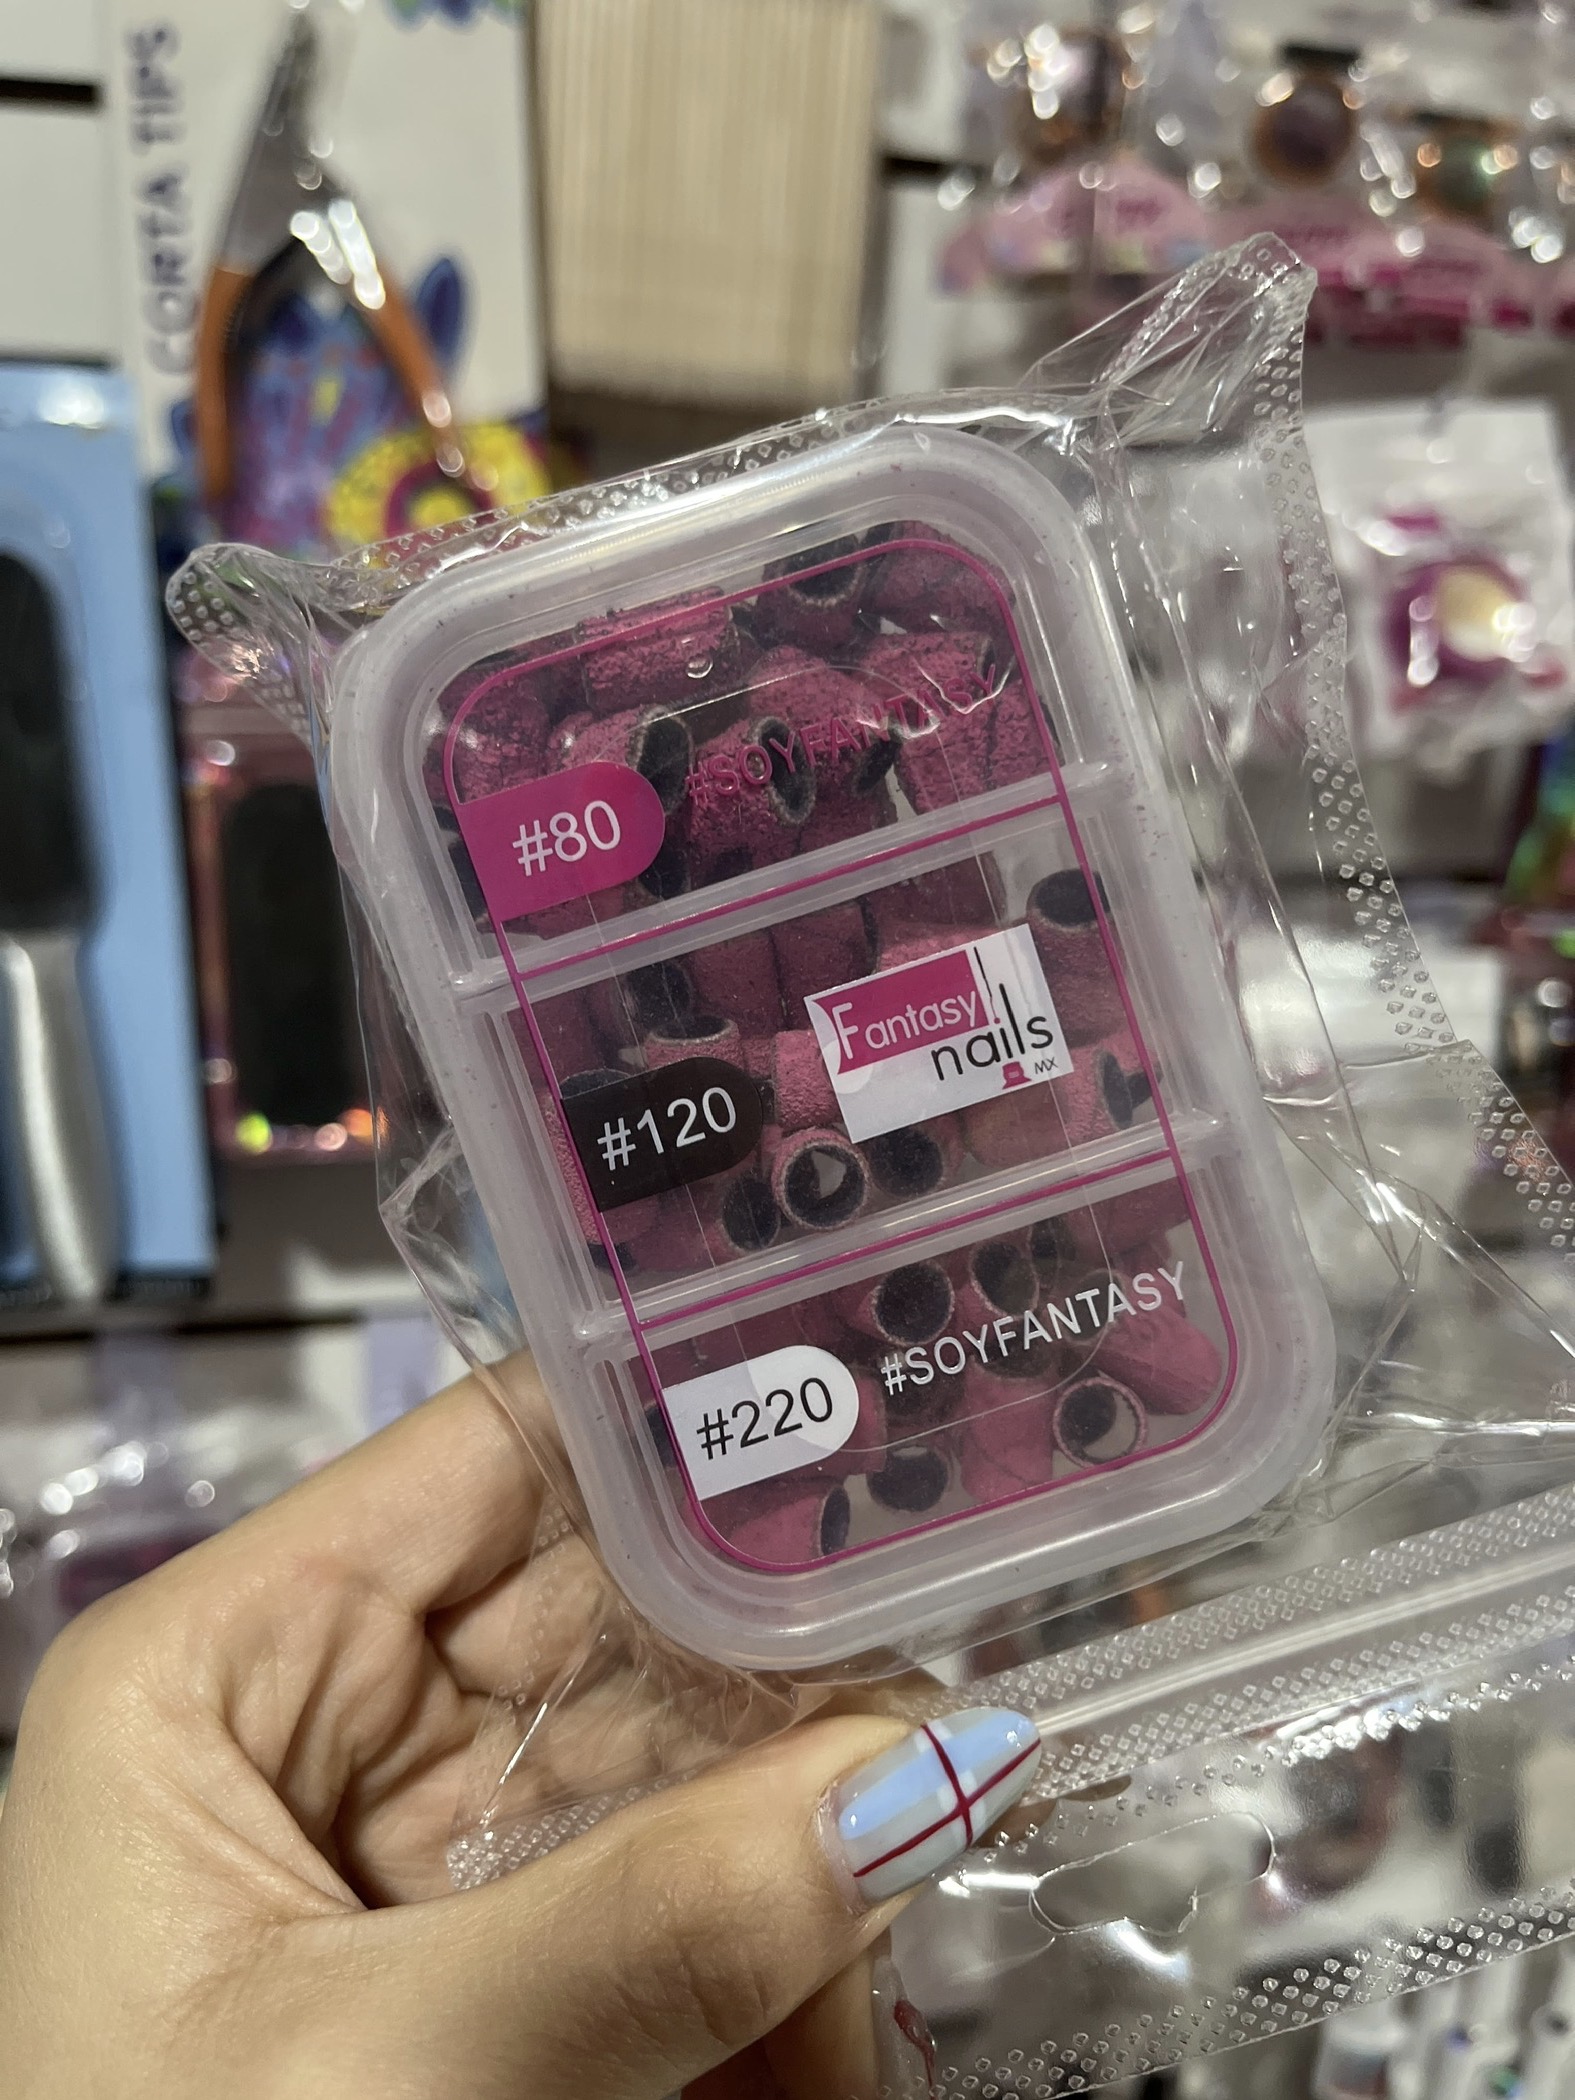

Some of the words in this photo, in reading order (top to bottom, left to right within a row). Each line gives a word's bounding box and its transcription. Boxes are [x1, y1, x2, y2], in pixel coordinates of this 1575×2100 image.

[128, 25, 181, 150] TIPS
[138, 174, 193, 374] CORTA
[687, 665, 997, 803] #SOYFANTASY
[512, 800, 621, 876] #80
[831, 990, 976, 1060] Fantasy
[931, 983, 1054, 1081] nails
[1034, 1057, 1059, 1074] MX
[597, 1085, 737, 1171] #120
[880, 1262, 1187, 1396] #SOYFANTASY
[696, 1376, 834, 1460] #220
